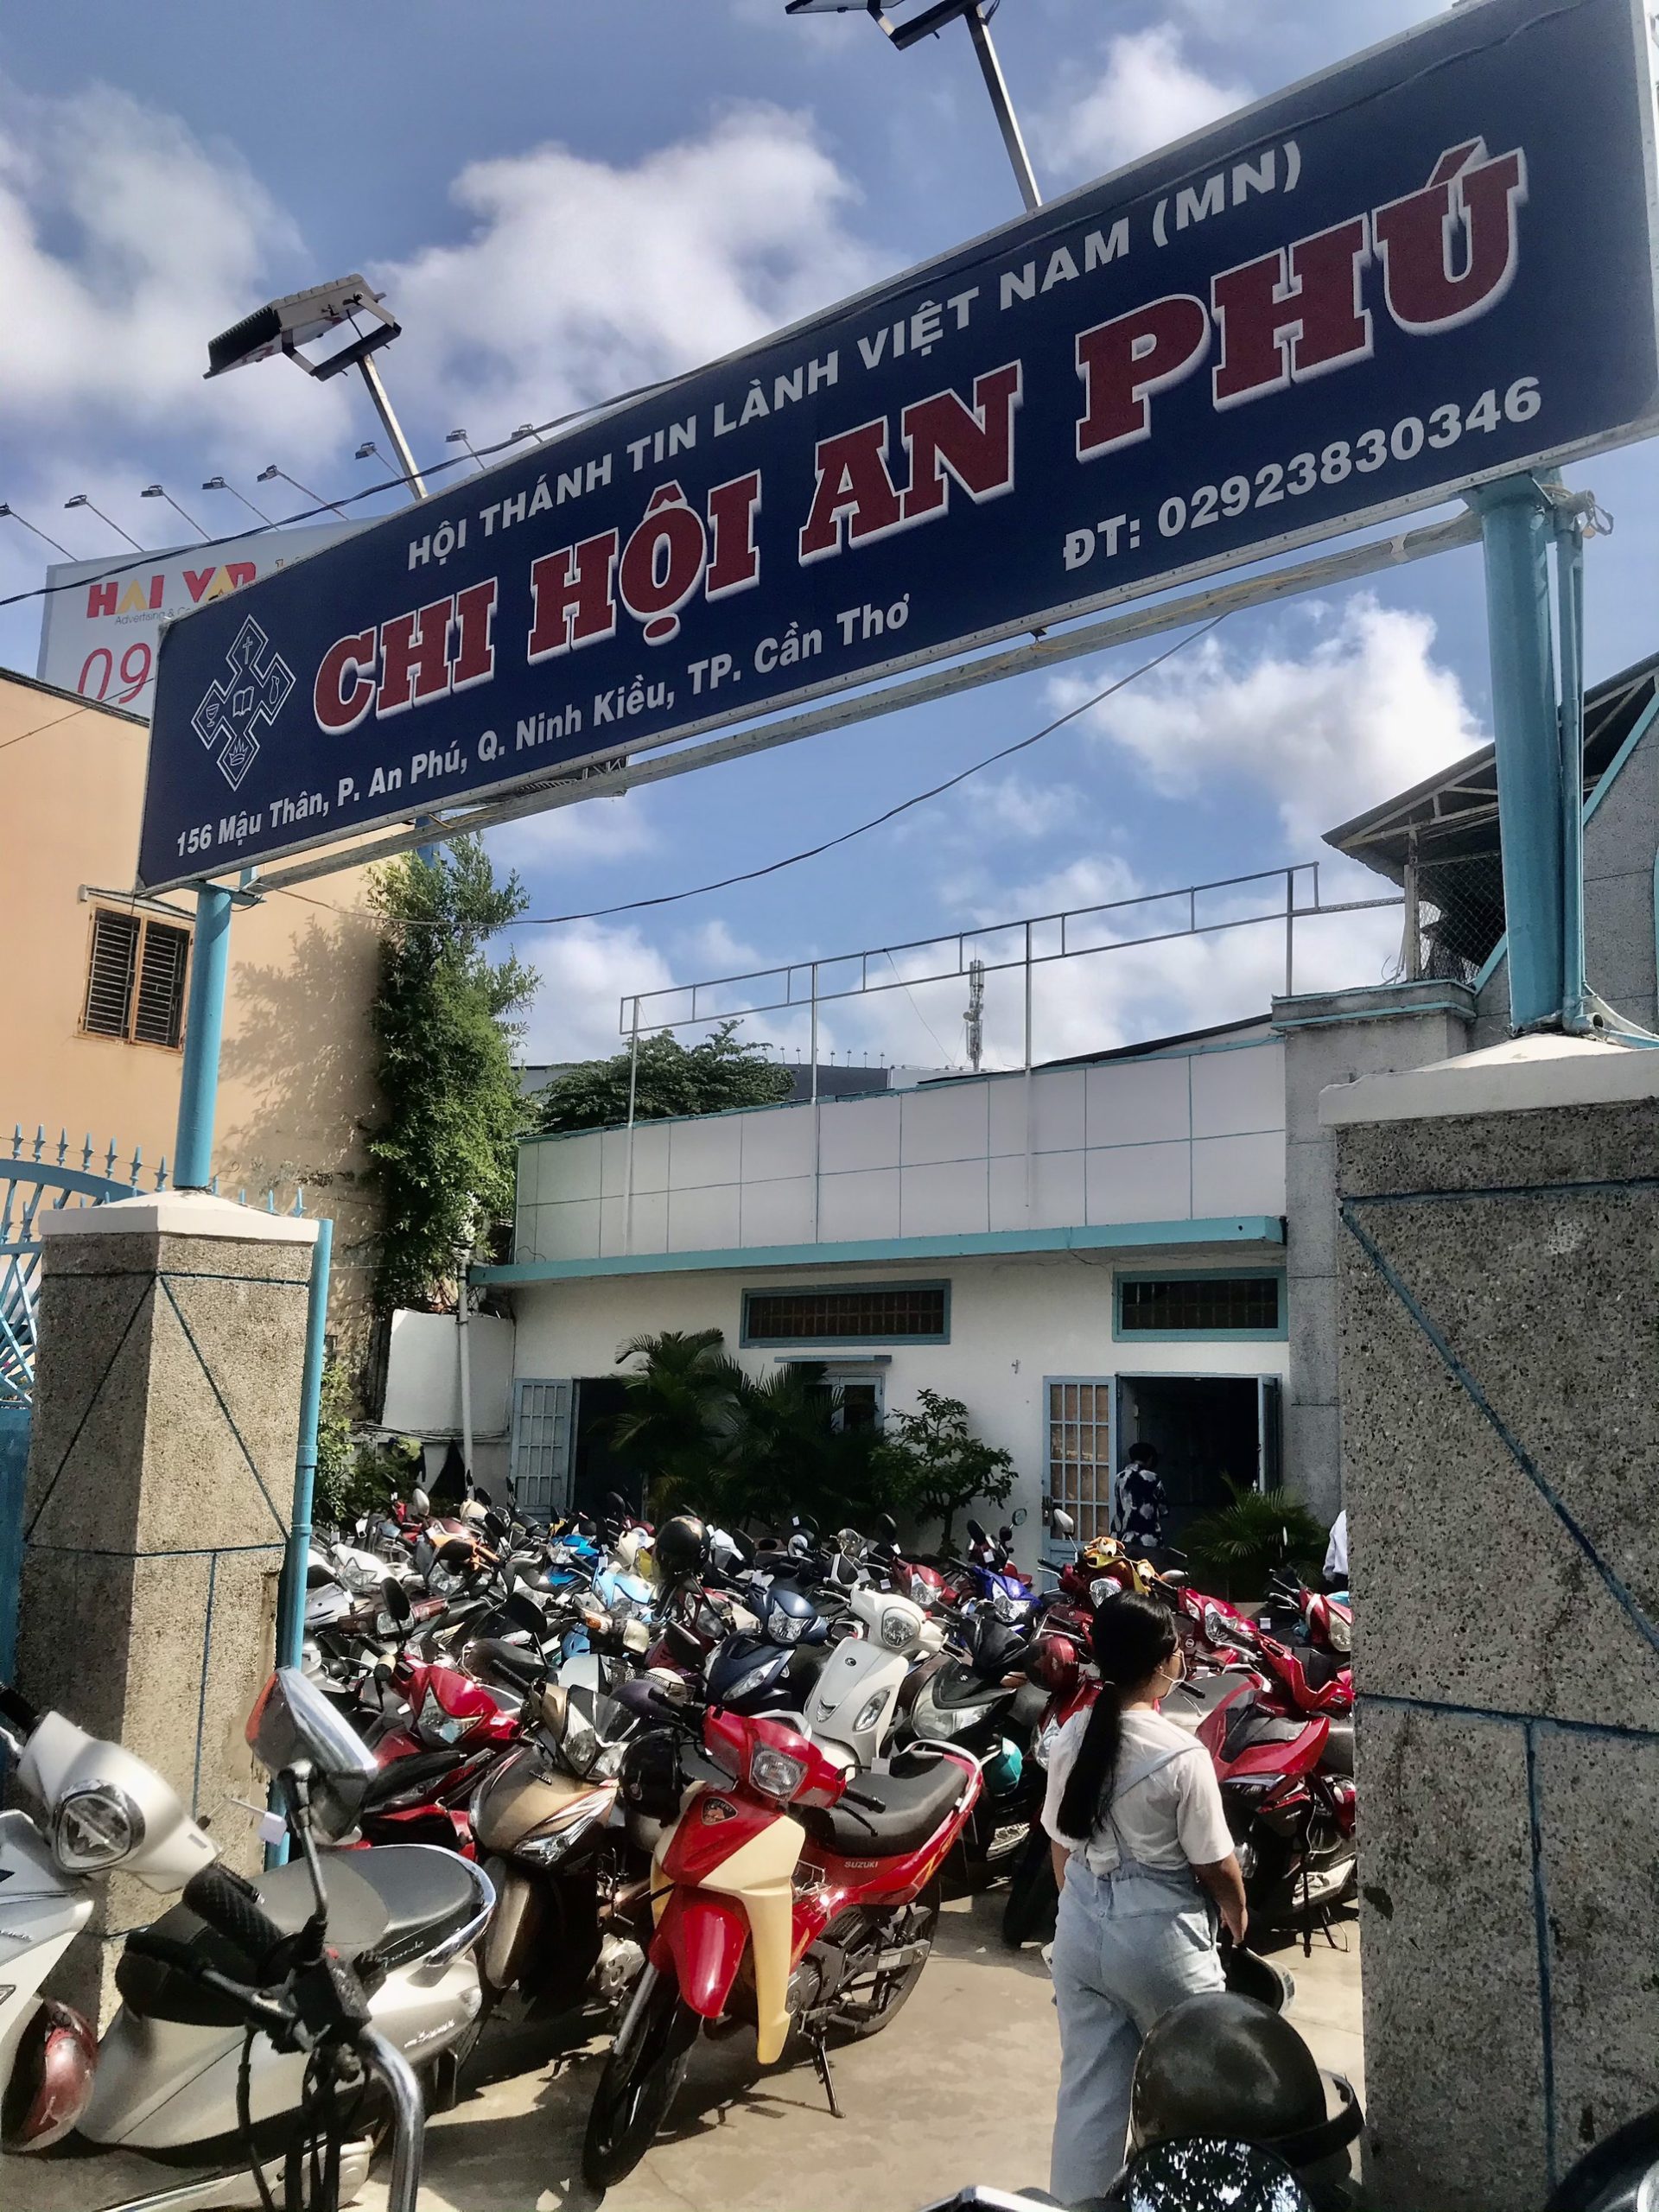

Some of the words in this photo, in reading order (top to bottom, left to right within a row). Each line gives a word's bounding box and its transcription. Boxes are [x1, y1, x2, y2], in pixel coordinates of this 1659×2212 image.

[313, 576, 499, 736] CHI
[526, 468, 762, 665] HỘI
[798, 359, 1024, 567] AN
[1074, 134, 1529, 463] PHÚ
[408, 518, 467, 570] HỘI
[479, 453, 612, 537] THÁNH
[626, 415, 696, 473] TIN
[714, 350, 839, 438] LÀNH
[856, 286, 980, 370] VIỆT
[1000, 217, 1129, 311] NAM
[1152, 141, 1301, 248] (MN)
[1063, 513, 1141, 572] ĐT:
[1157, 375, 1542, 538] 02923830346
[87, 575, 164, 618] HAI
[115, 610, 165, 625] Advertising
[177, 823, 213, 857] 156
[218, 810, 261, 848] Mậu
[269, 791, 329, 829] Thân,
[337, 777, 361, 808] P.
[367, 766, 404, 798] An
[410, 741, 467, 782] Phú,
[478, 729, 505, 761] Q.
[516, 702, 582, 750] Ninh
[594, 674, 675, 727] Kiều,
[687, 652, 741, 695] TP.
[754, 621, 823, 674] Cần
[836, 594, 910, 645] Thơ
